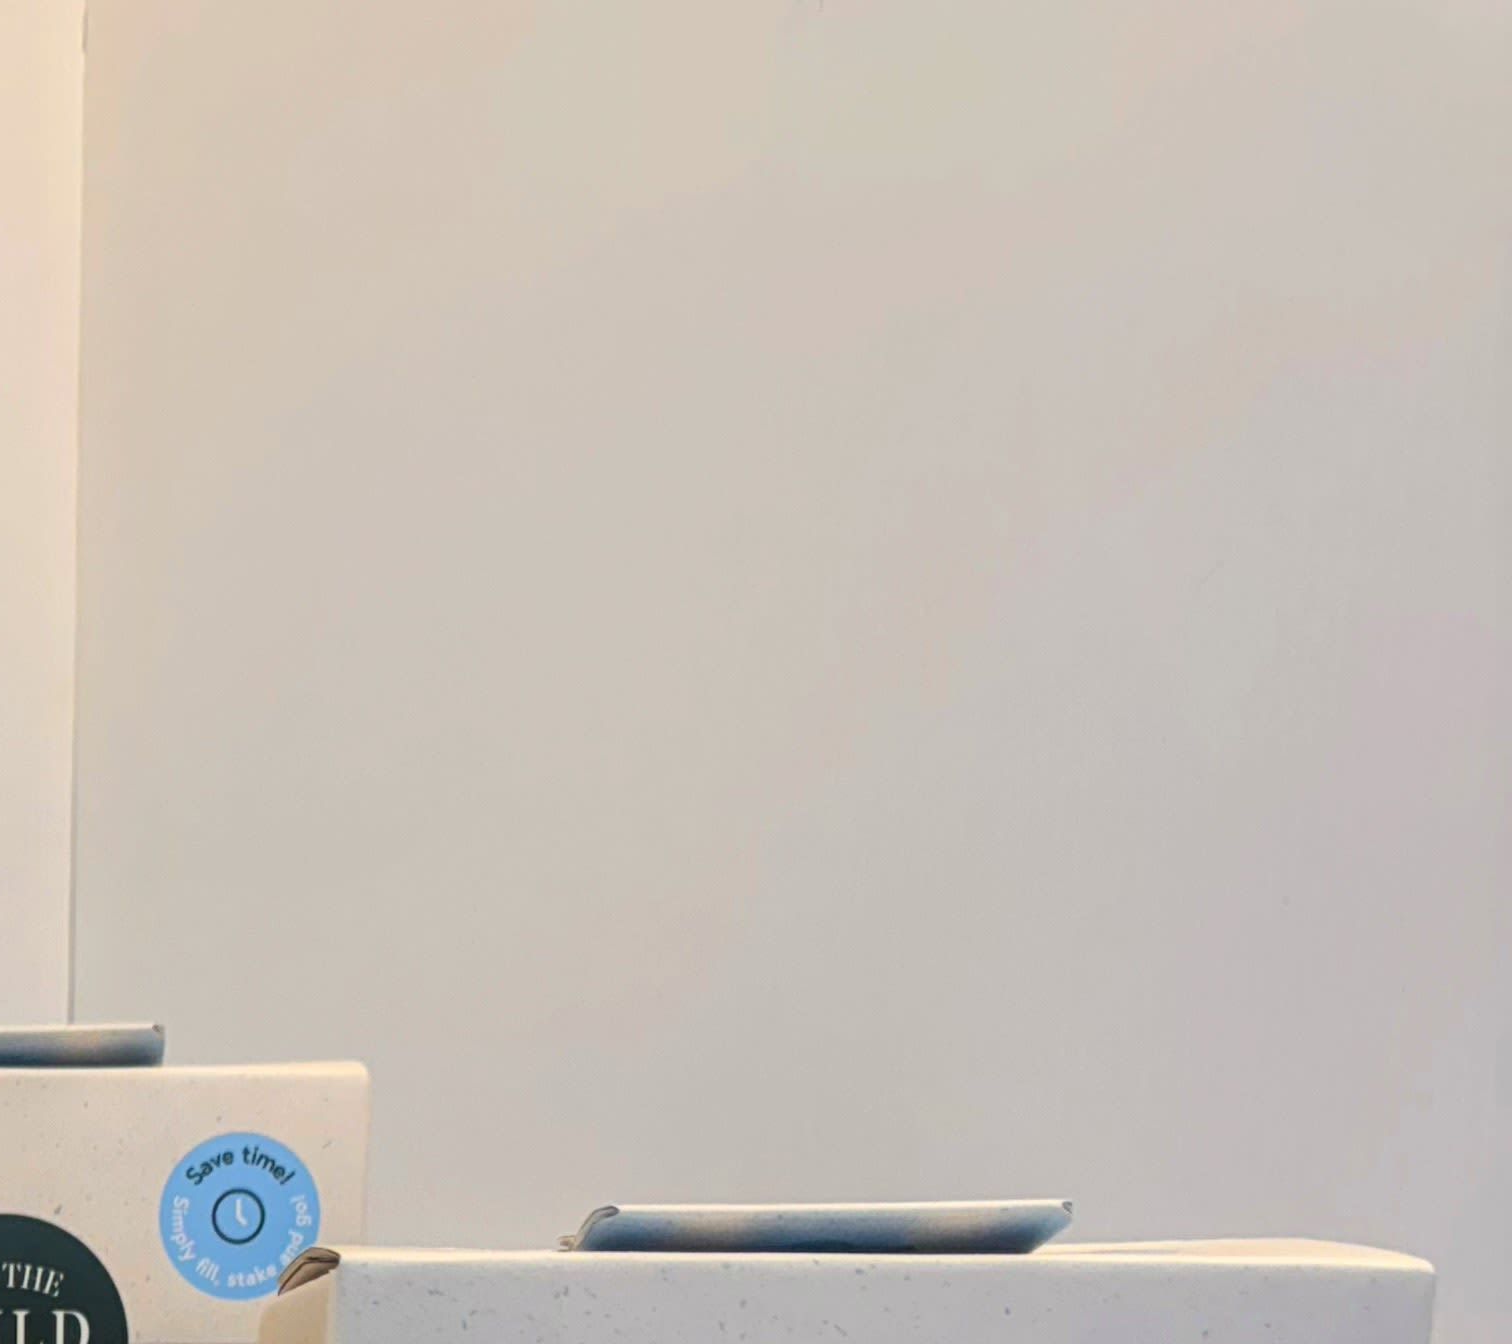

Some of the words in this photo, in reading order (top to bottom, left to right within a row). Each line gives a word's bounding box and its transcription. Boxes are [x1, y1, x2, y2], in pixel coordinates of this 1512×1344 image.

[186, 1151, 234, 1185] Save
[242, 1146, 295, 1184] time!
[171, 1196, 195, 1261] Simply
[227, 1264, 276, 1287] stake
[2, 1262, 64, 1297] THE
